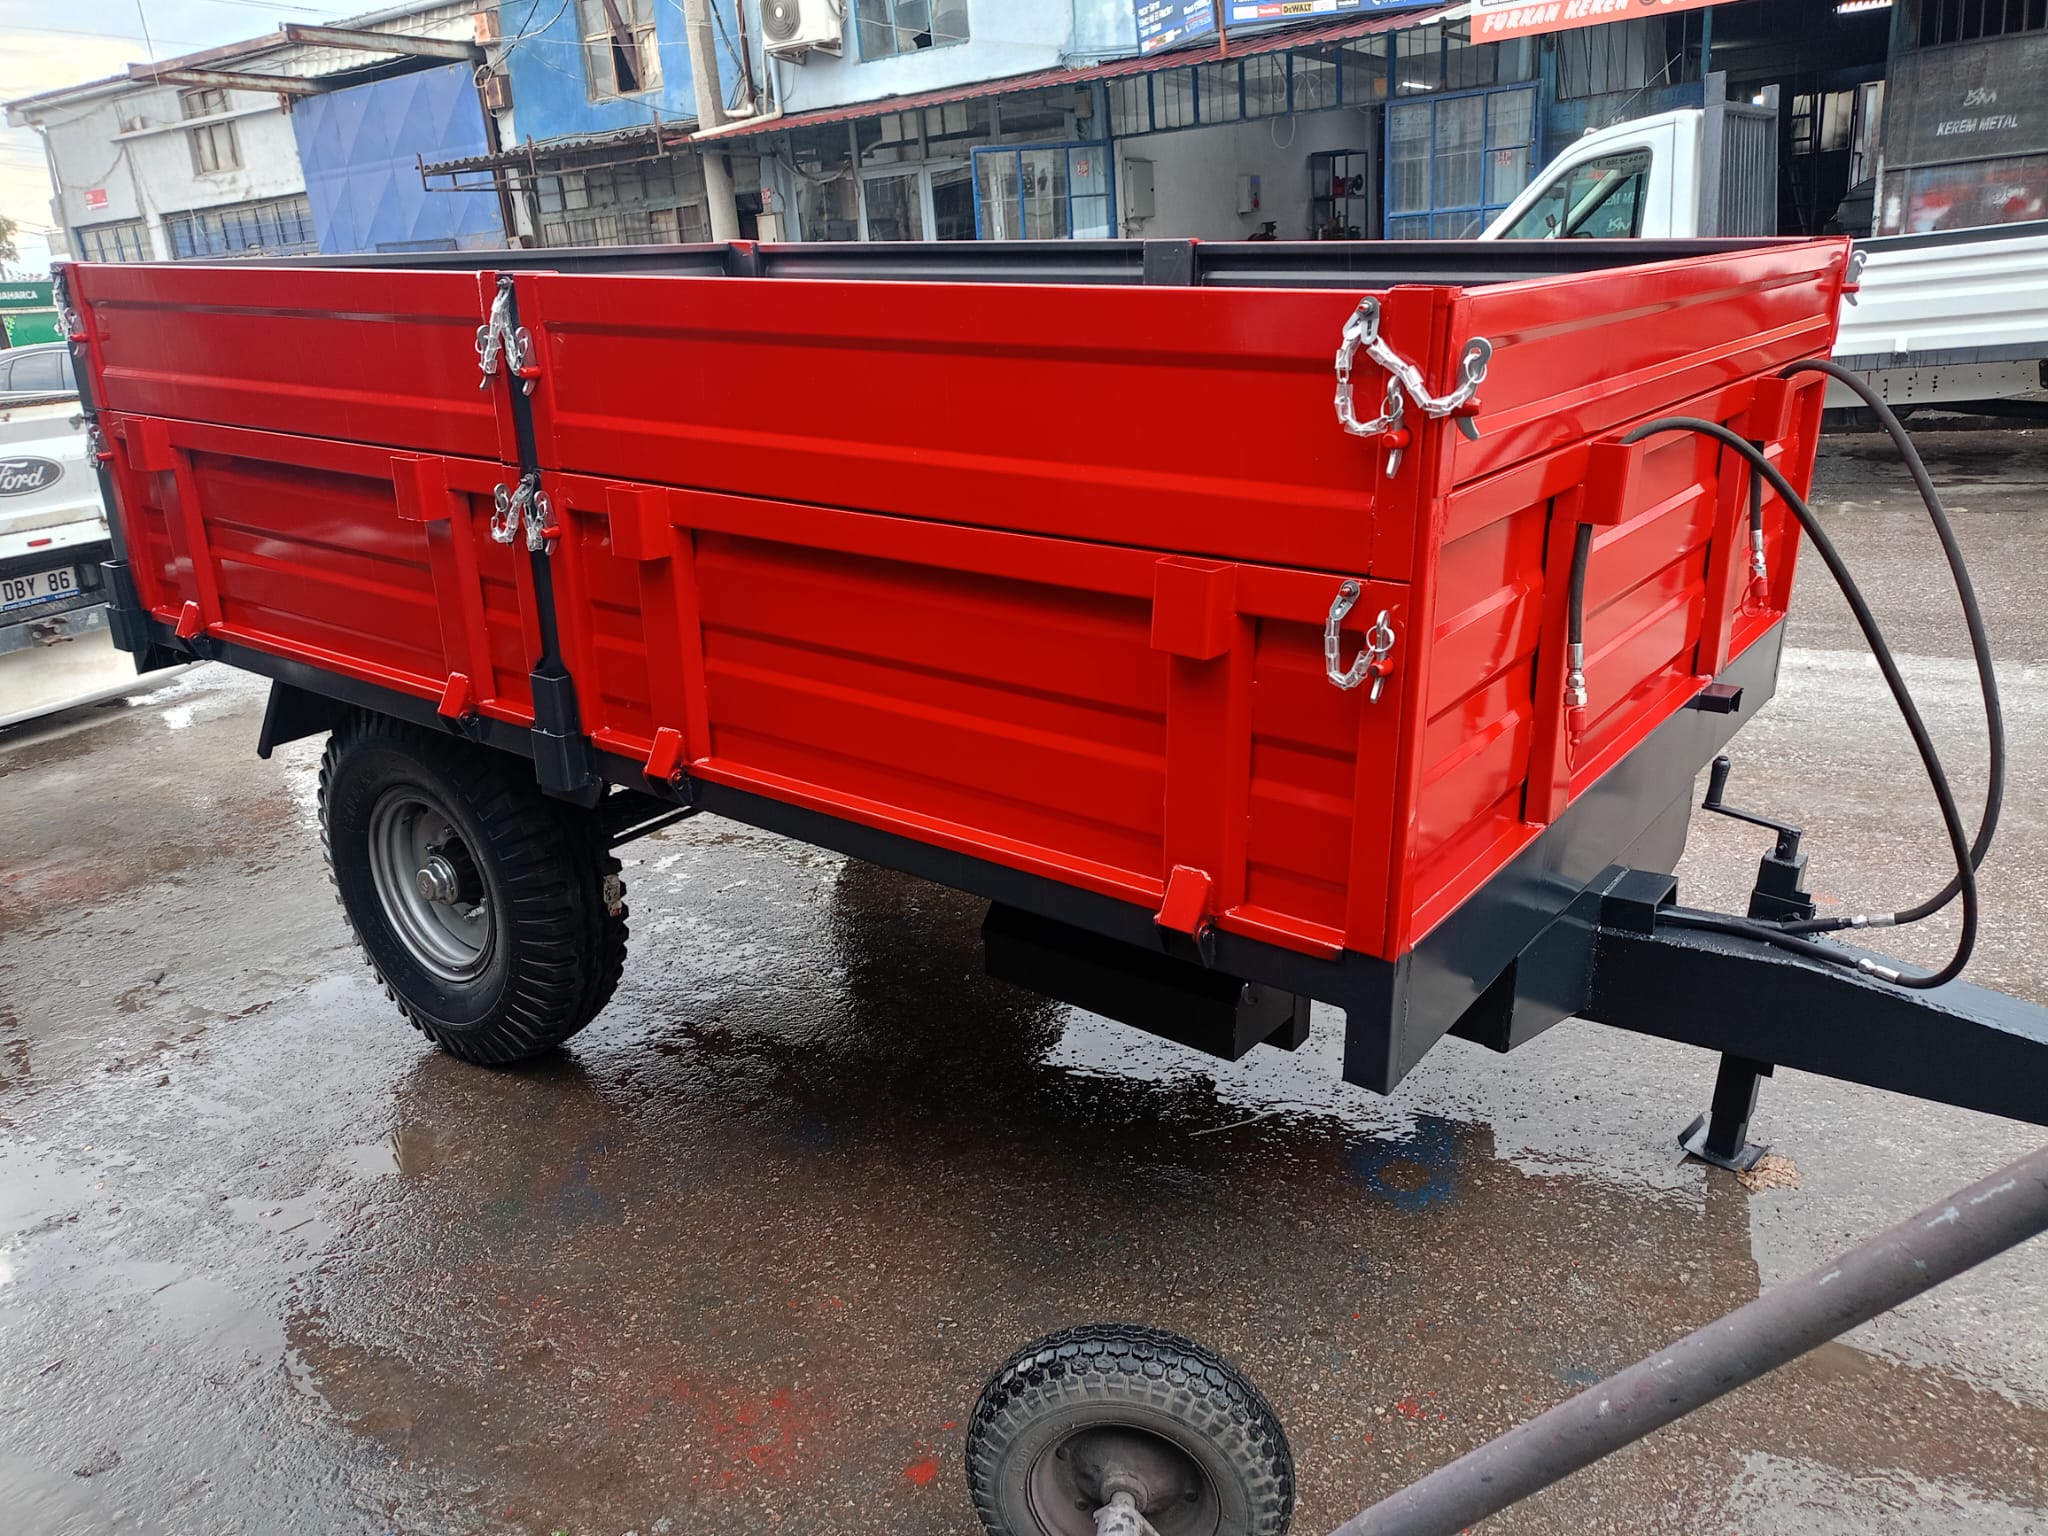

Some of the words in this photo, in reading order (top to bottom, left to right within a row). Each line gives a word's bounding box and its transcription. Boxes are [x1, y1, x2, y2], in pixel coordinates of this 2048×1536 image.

[1482, 5, 1560, 33] FURKAN
[1936, 118, 1978, 136] KEREM
[1979, 114, 2018, 131] METAL
[3, 576, 36, 602] DBY
[48, 570, 71, 592] 86
